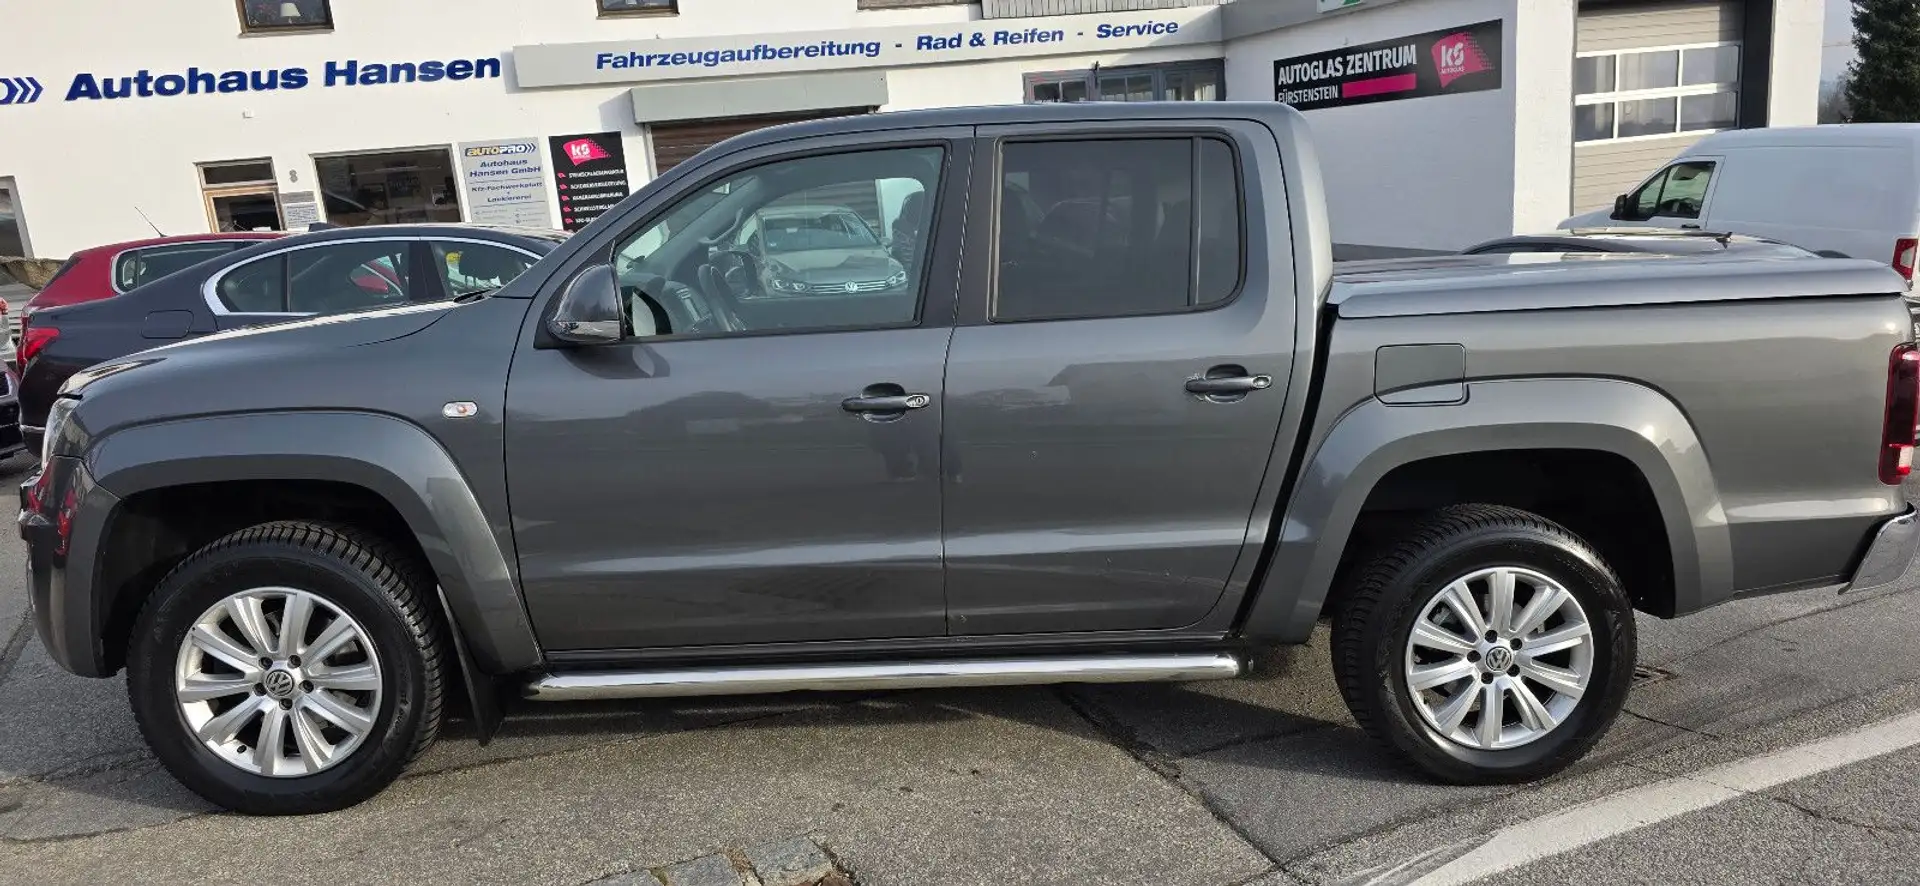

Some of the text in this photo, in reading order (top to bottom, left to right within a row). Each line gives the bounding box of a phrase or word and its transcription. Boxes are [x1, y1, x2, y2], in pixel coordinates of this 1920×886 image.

[596, 40, 880, 70] Fahrzeugaufbereitung
[916, 33, 962, 51] Rad
[969, 32, 986, 48] &
[992, 26, 1064, 45] Reifen
[1096, 19, 1179, 39] Service
[65, 57, 501, 101] Autohaus Hansen
[1278, 44, 1417, 85] AUTOGLAS ZENTRUM
[1278, 85, 1338, 105] FÜRSTENSTEIN
[469, 165, 541, 178] Hansen GmbH
[480, 158, 528, 168] Autohaus
